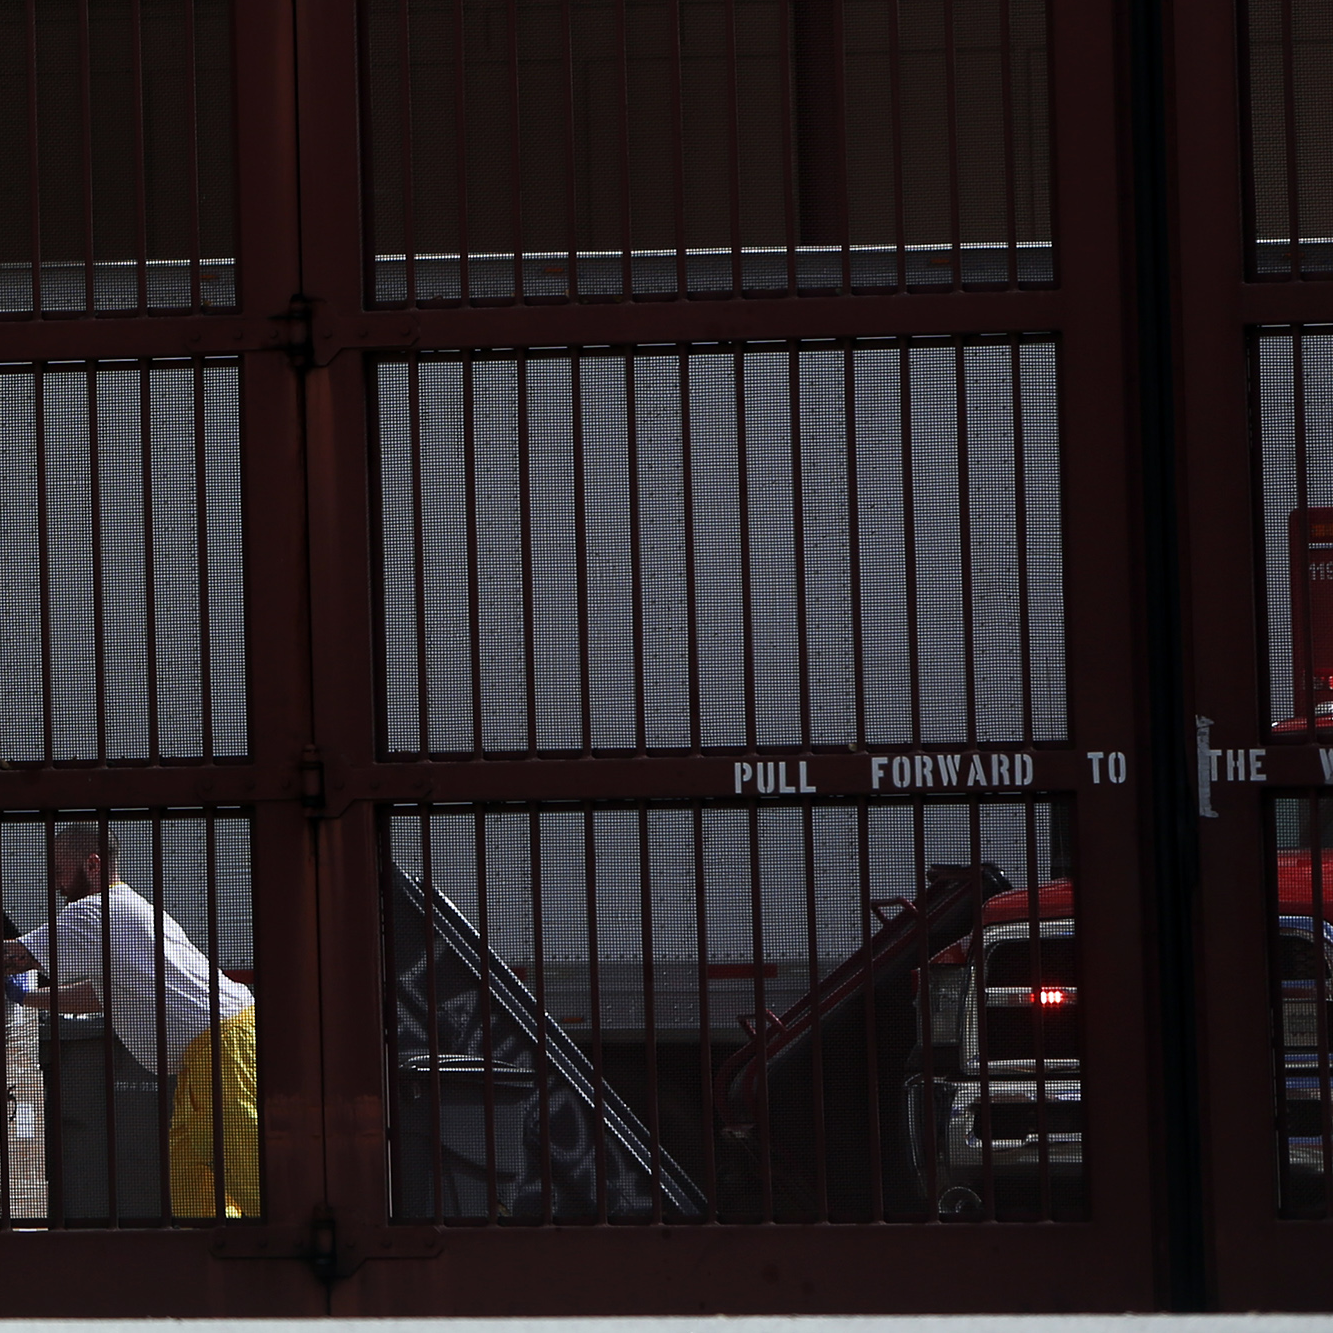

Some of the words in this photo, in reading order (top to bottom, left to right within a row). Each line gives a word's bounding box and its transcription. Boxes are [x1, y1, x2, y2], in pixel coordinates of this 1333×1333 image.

[735, 761, 816, 793] PULL
[872, 754, 1032, 788] FORWARD
[1088, 752, 1125, 783] TO
[1206, 749, 1266, 780] THE
